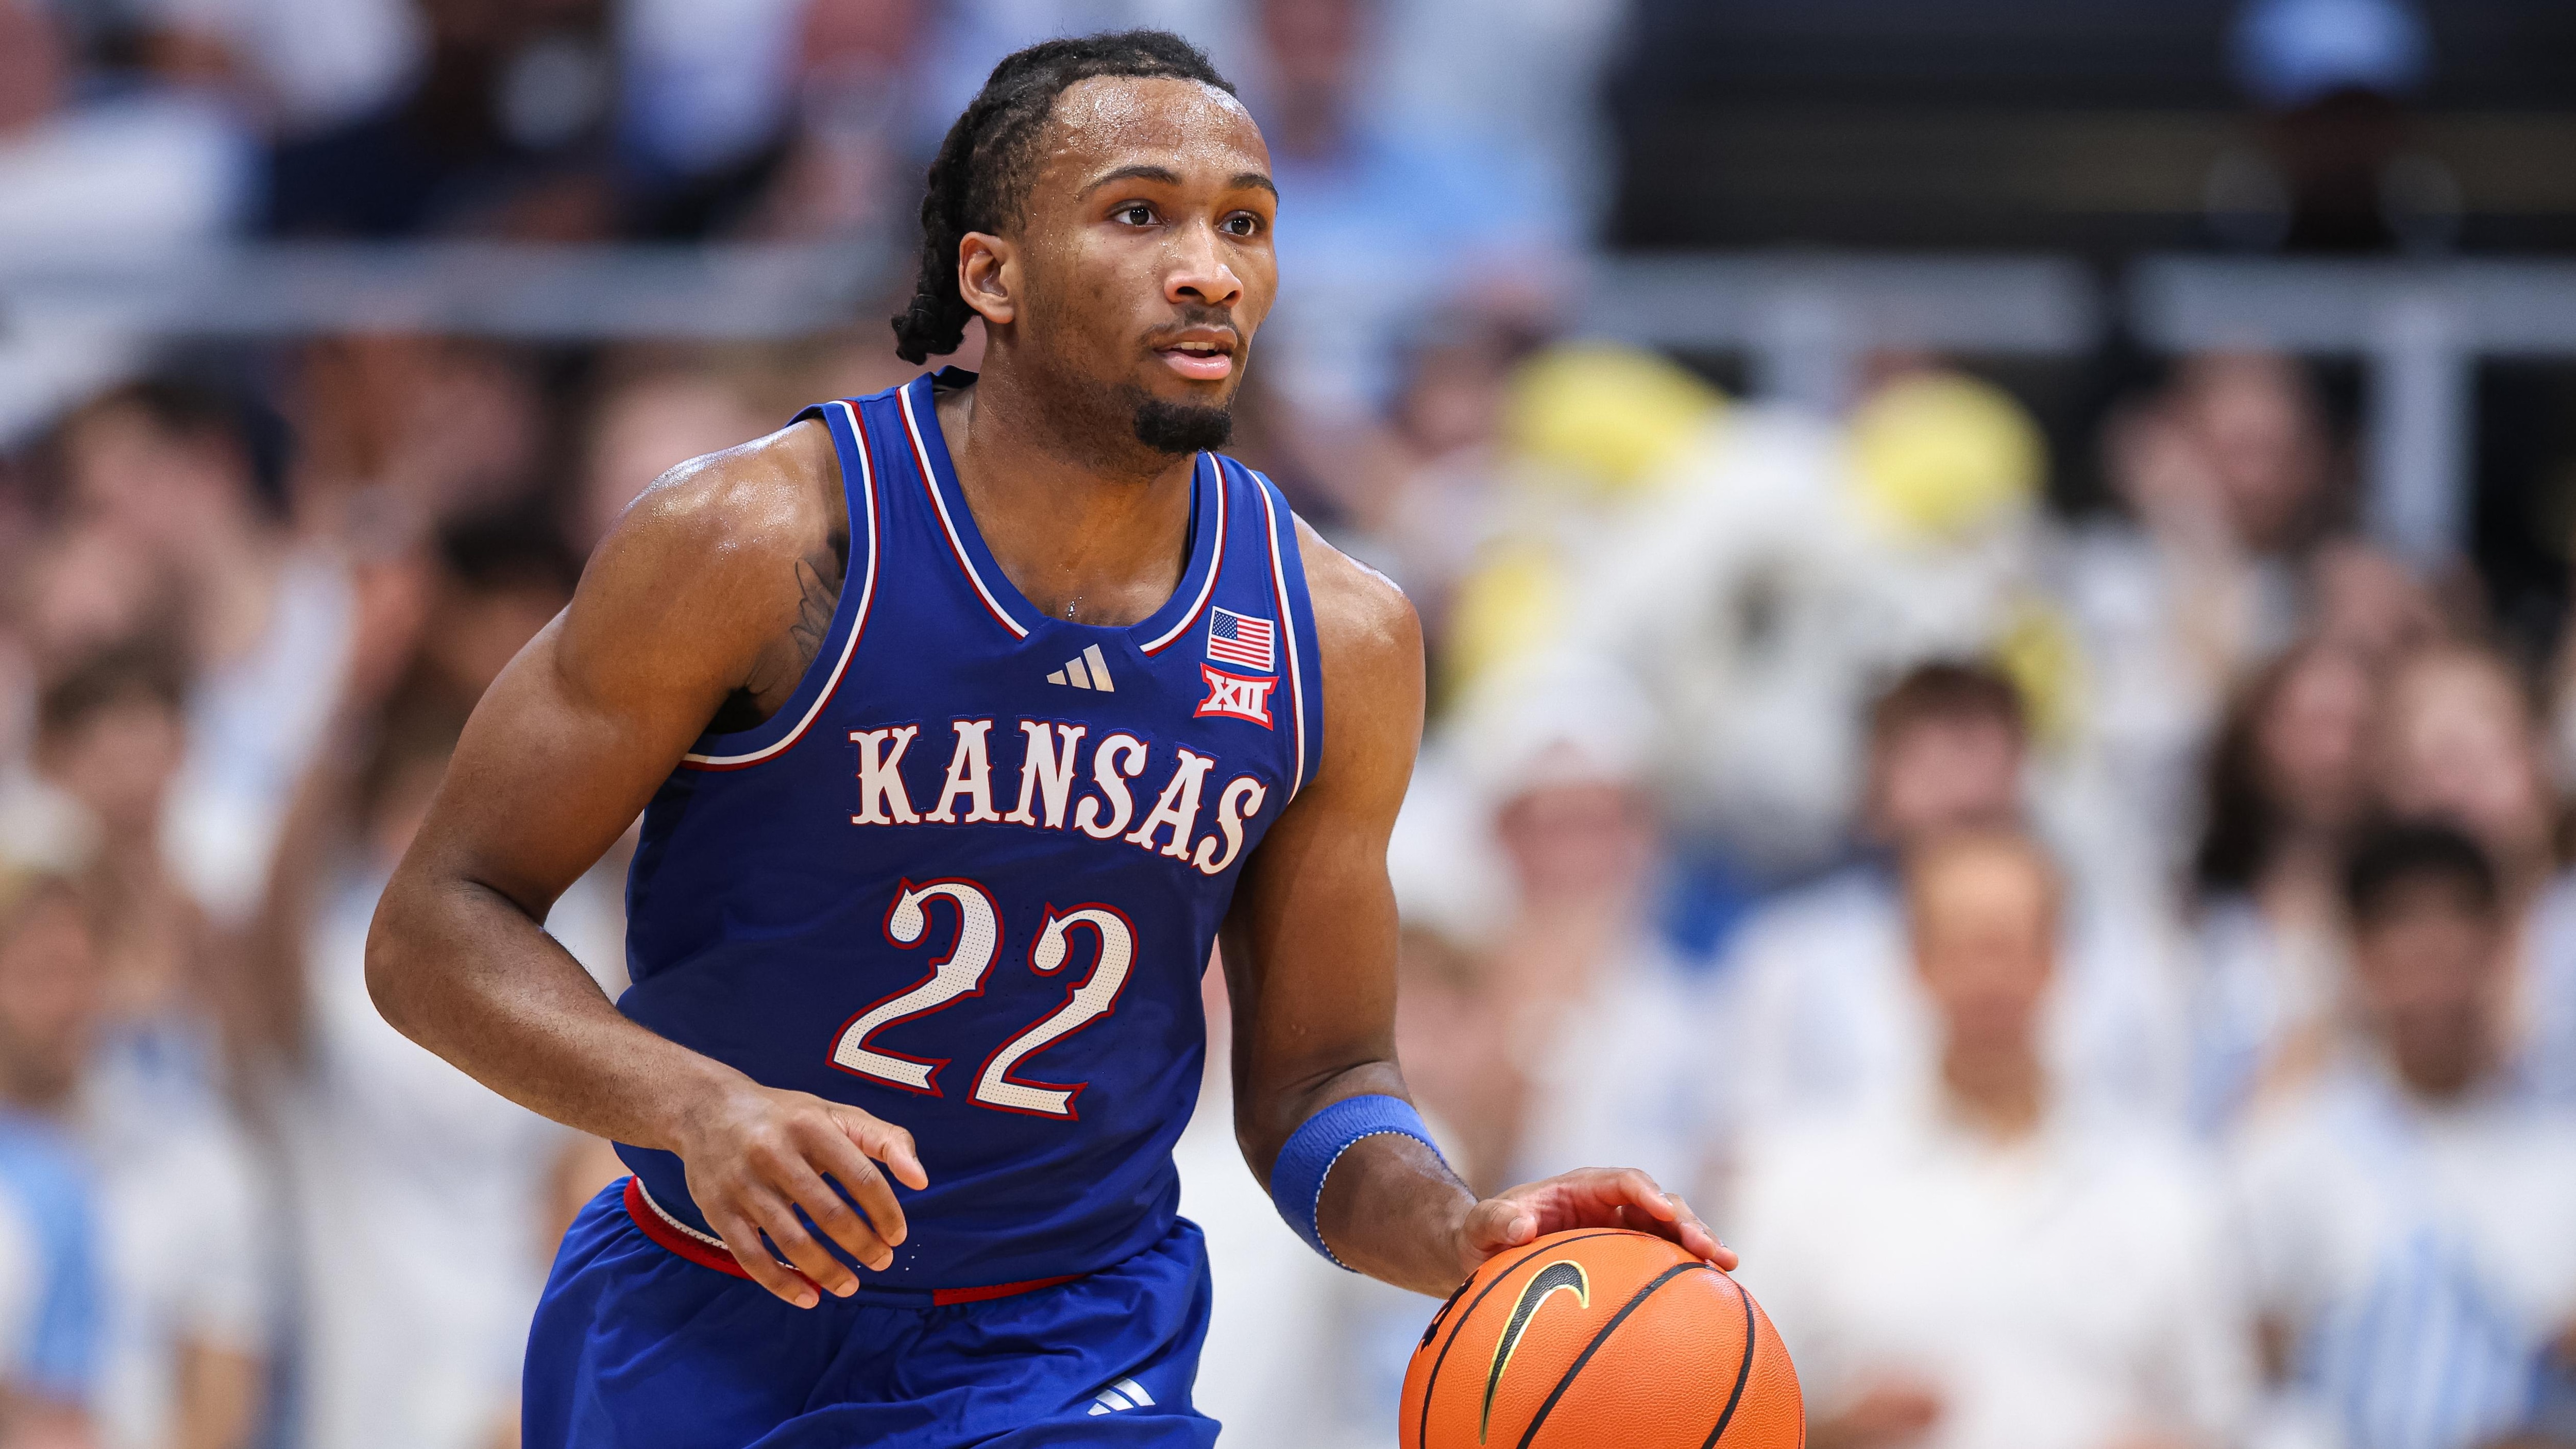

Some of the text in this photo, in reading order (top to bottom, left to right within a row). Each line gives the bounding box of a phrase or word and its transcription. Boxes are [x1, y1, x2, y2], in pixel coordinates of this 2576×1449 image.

[1198, 669, 1274, 724] XII
[848, 718, 1268, 876] KANSAS
[825, 877, 1139, 1121] 22
